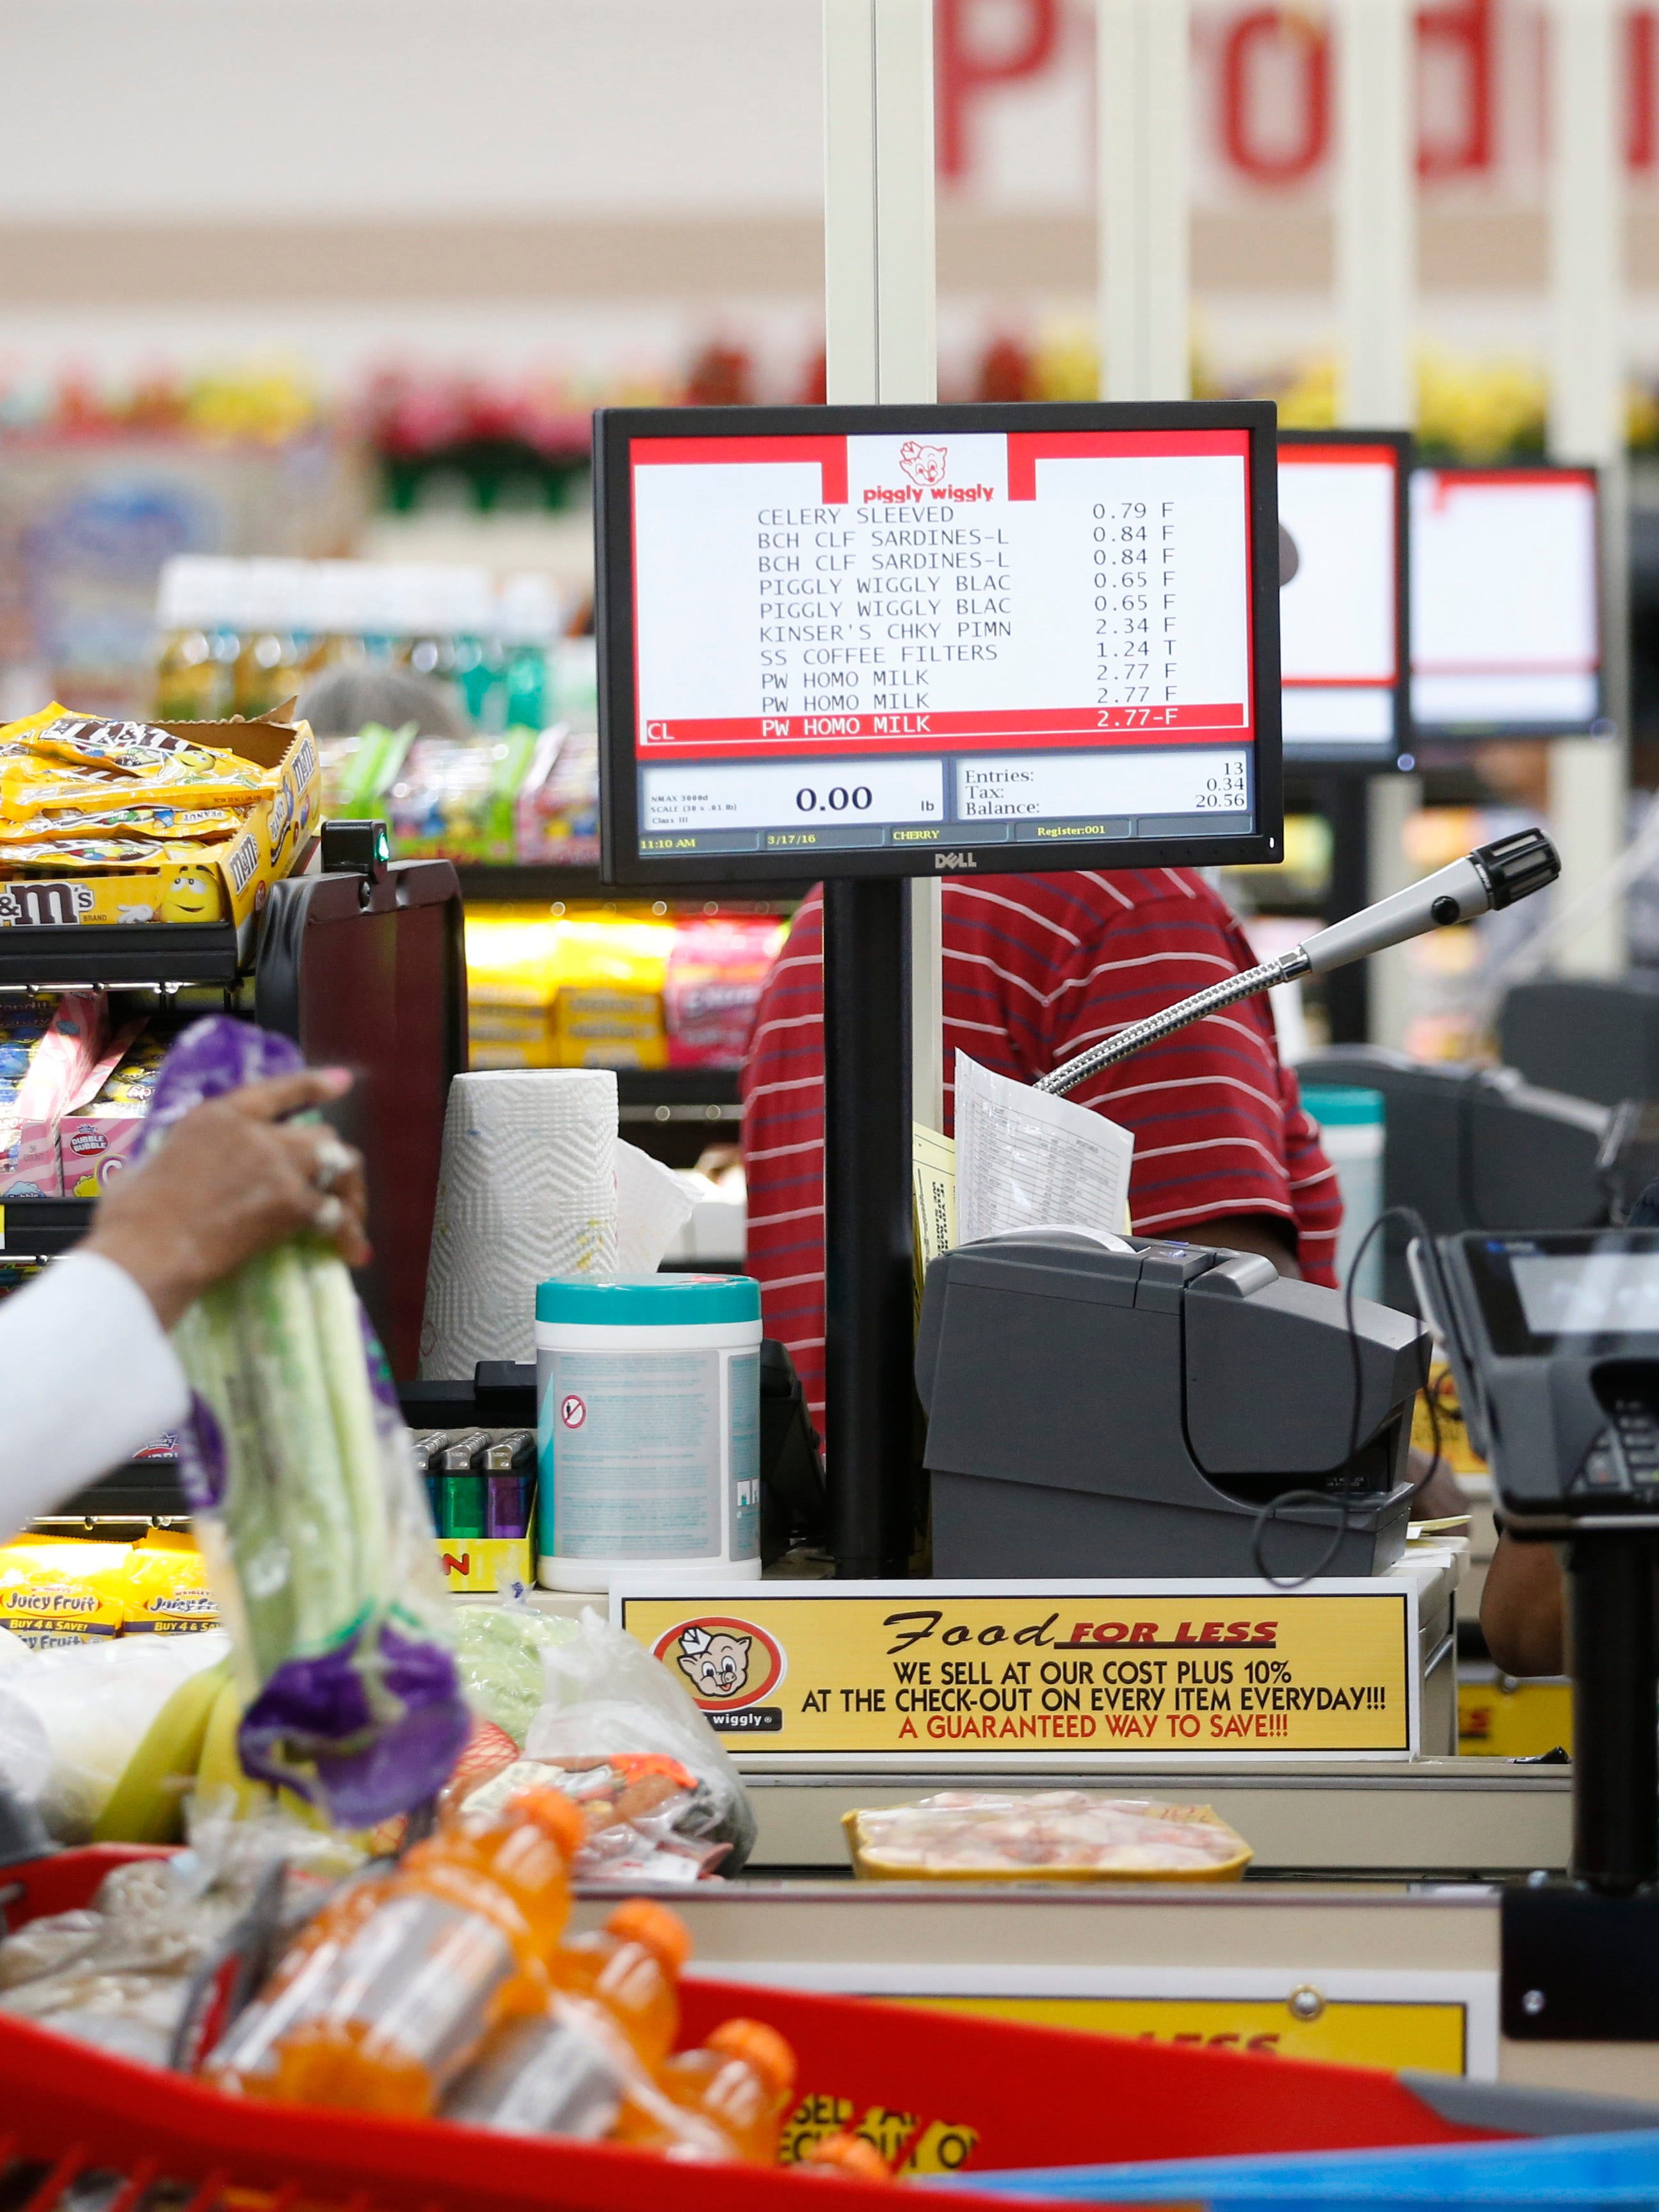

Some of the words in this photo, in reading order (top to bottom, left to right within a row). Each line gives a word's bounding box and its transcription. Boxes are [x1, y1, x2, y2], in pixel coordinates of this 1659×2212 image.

[863, 485, 923, 504] piggly
[931, 483, 994, 502] wiggly
[758, 509, 841, 526] CELERY
[857, 506, 954, 524] SLEEVED
[1093, 502, 1147, 519] 0.79
[1162, 502, 1175, 518] F
[758, 533, 800, 549] BCH
[815, 531, 856, 548] CLF
[872, 529, 1010, 547] SARDINES-L
[1093, 525, 1148, 543] 0.84
[1162, 525, 1175, 541] F
[758, 556, 800, 573] BCH
[815, 554, 856, 572] CLF
[872, 552, 1010, 570] SARDINES-L
[1094, 549, 1148, 565] 0.84
[1163, 548, 1176, 564] F
[760, 579, 843, 596] PIGGLY
[857, 577, 941, 594] WIGGLY
[956, 575, 1011, 591] BLAC
[1094, 572, 1147, 588] 0.65
[1163, 571, 1176, 587] F
[760, 602, 843, 620] PIGGLY
[857, 600, 942, 616] WIGGLY
[957, 598, 1011, 614] BLAC
[1094, 595, 1148, 611] 0.65
[1164, 594, 1176, 610] F
[760, 625, 871, 643] KINSER'S
[887, 623, 942, 640] CHKY
[959, 621, 1012, 638] PIMN
[1095, 618, 1150, 634] 2.34
[1164, 617, 1176, 633] F
[760, 649, 788, 666] SS
[803, 647, 885, 664] COFFEE
[902, 644, 998, 663] FILTERS
[1096, 641, 1150, 657] 1.24
[1164, 640, 1177, 656] T
[762, 673, 789, 689] PW
[804, 671, 859, 688] HOMO
[873, 669, 929, 686] MILK
[1096, 664, 1150, 680] 2.77
[1165, 662, 1178, 679] F
[1097, 687, 1150, 703] 2.77
[1166, 685, 1178, 701] F
[762, 696, 789, 713] PW
[804, 694, 860, 711] HOMO
[874, 693, 929, 709] MILK
[1097, 708, 1179, 727] 2.77-F
[647, 723, 674, 740] CL
[762, 719, 789, 737] PW
[804, 718, 860, 735] HOMO
[874, 716, 931, 733] MILK
[965, 769, 1034, 784] Entries:
[1223, 761, 1244, 776] 13
[966, 785, 1005, 799] Tax:
[1206, 777, 1245, 792] 0.34
[796, 786, 872, 813] 0.00
[920, 800, 935, 812] lb
[1194, 794, 1246, 808] 20.56
[965, 801, 1041, 816] Balance:
[767, 833, 816, 845] 3/17/16
[893, 830, 940, 842] CHERRY
[1037, 825, 1106, 838] Register:001
[641, 839, 673, 849] 11:10
[675, 838, 696, 848] AM
[934, 852, 977, 869] DELL
[83, 914, 108, 922] BRAND
[71, 1135, 105, 1145] DUBBLE
[74, 1142, 107, 1152] BUBBLE
[6, 1592, 51, 1610] Juicy
[54, 1595, 95, 1611] Fruit
[10, 1619, 33, 1629] BUY
[34, 1619, 44, 1629] 4
[45, 1621, 53, 1629] &
[55, 1621, 89, 1632] SAVE!
[154, 1622, 177, 1631] BUY
[179, 1622, 188, 1631] 4
[883, 1610, 1059, 1655] Food
[1071, 1622, 1159, 1643] FOR
[1174, 1621, 1279, 1643] LESS
[894, 1662, 932, 1685] WE
[941, 1662, 993, 1685] SELL
[1000, 1662, 1032, 1685] AT
[1039, 1661, 1094, 1685] OUR
[1102, 1660, 1167, 1685] COST
[1177, 1660, 1233, 1684] PLUS
[1244, 1660, 1292, 1684] 10%
[801, 1689, 837, 1713] AT
[840, 1689, 886, 1712] THE
[895, 1688, 1033, 1712] CHECK-OUT
[1041, 1687, 1081, 1711] ON
[1091, 1687, 1166, 1711] EVERY
[1174, 1687, 1231, 1711] ITEM
[1241, 1686, 1386, 1711] EVERYDAY!!!
[712, 1713, 762, 1726] wiggly
[898, 1715, 918, 1738] A
[926, 1714, 1096, 1738] GUARANTEED
[1105, 1714, 1158, 1738] WAY
[1166, 1714, 1201, 1738] TO
[1210, 1713, 1288, 1738] SAVE!!!
